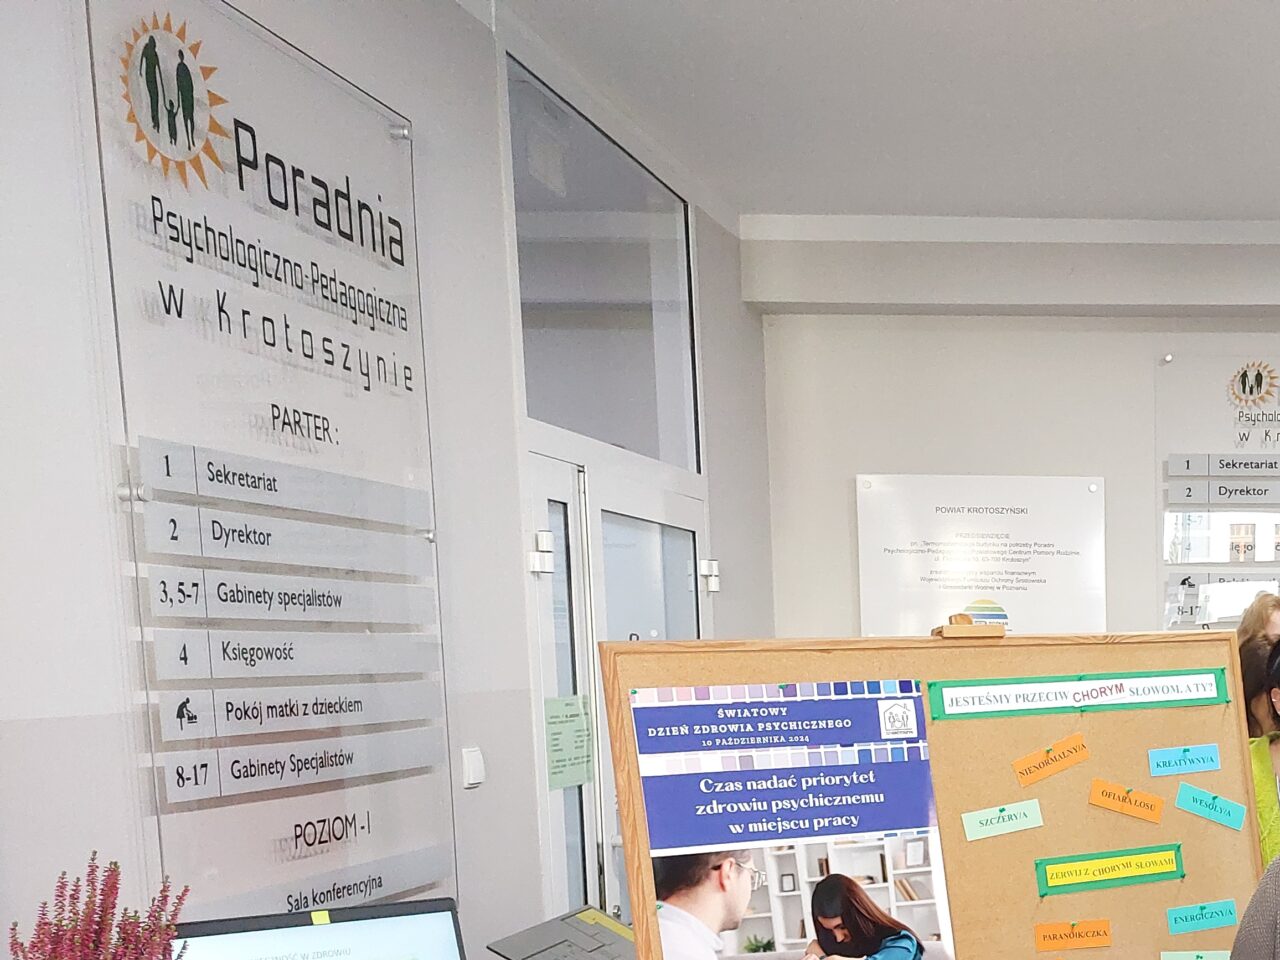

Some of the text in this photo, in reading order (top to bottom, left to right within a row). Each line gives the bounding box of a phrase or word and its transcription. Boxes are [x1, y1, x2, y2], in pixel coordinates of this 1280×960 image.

[233, 118, 405, 267] Poradnia
[151, 195, 408, 331] Psychologiczno-Pedagogiczna
[216, 289, 413, 391] Krotoszynie
[164, 455, 278, 493] 1 Sekretariat
[1185, 459, 1279, 470] 1 Sekretariat
[1185, 486, 1269, 499] 2 Dyrektor
[935, 505, 1028, 515] POWIAT KROTOSZYŃSKI
[168, 518, 272, 551] 2 Dyrektor
[177, 581, 200, 605] 5-7
[216, 582, 274, 613] Gabinety
[277, 585, 342, 613] specjalistów
[178, 640, 294, 669] 4 Księgowość
[949, 692, 1011, 708] JESTEŚMY
[1015, 690, 1071, 704] PRZECIW
[1072, 683, 1125, 702] CHORYM
[1194, 682, 1214, 693] TY?
[225, 696, 363, 726] Pokój matki z dzieckiem
[717, 706, 788, 718] ŚWIATOWY
[648, 719, 852, 737] DZIEŃ ZDROWIA PSYCHICZNEGO
[702, 735, 810, 747] 10 PAŹDZIERNIKA 2024
[176, 747, 354, 790] 8-17 Gabinety Specjalistów
[1018, 742, 1087, 779] NIENORMALNY/A
[1156, 754, 1215, 769] KREATYWNY/A
[700, 770, 876, 793] Czas nadać priorytet
[695, 792, 884, 816] zdrowiu psychicznemu
[1101, 788, 1156, 812] OFIARA LOSU
[728, 814, 860, 835] w miejscu pracy
[979, 811, 1028, 828] SZCZERY/A
[293, 815, 358, 852] POZIOM
[1049, 867, 1083, 881] ZERWIJ
[1092, 861, 1133, 878] CHORYMI
[1135, 857, 1175, 870] SŁOWAMI
[286, 873, 384, 914] Sala konferencyjna
[1173, 909, 1234, 925] ENERGICZNY/A
[1042, 929, 1108, 942] PARANOIK/CZKA
[300, 953, 309, 960] W
[311, 948, 351, 960] ZDROWIU
